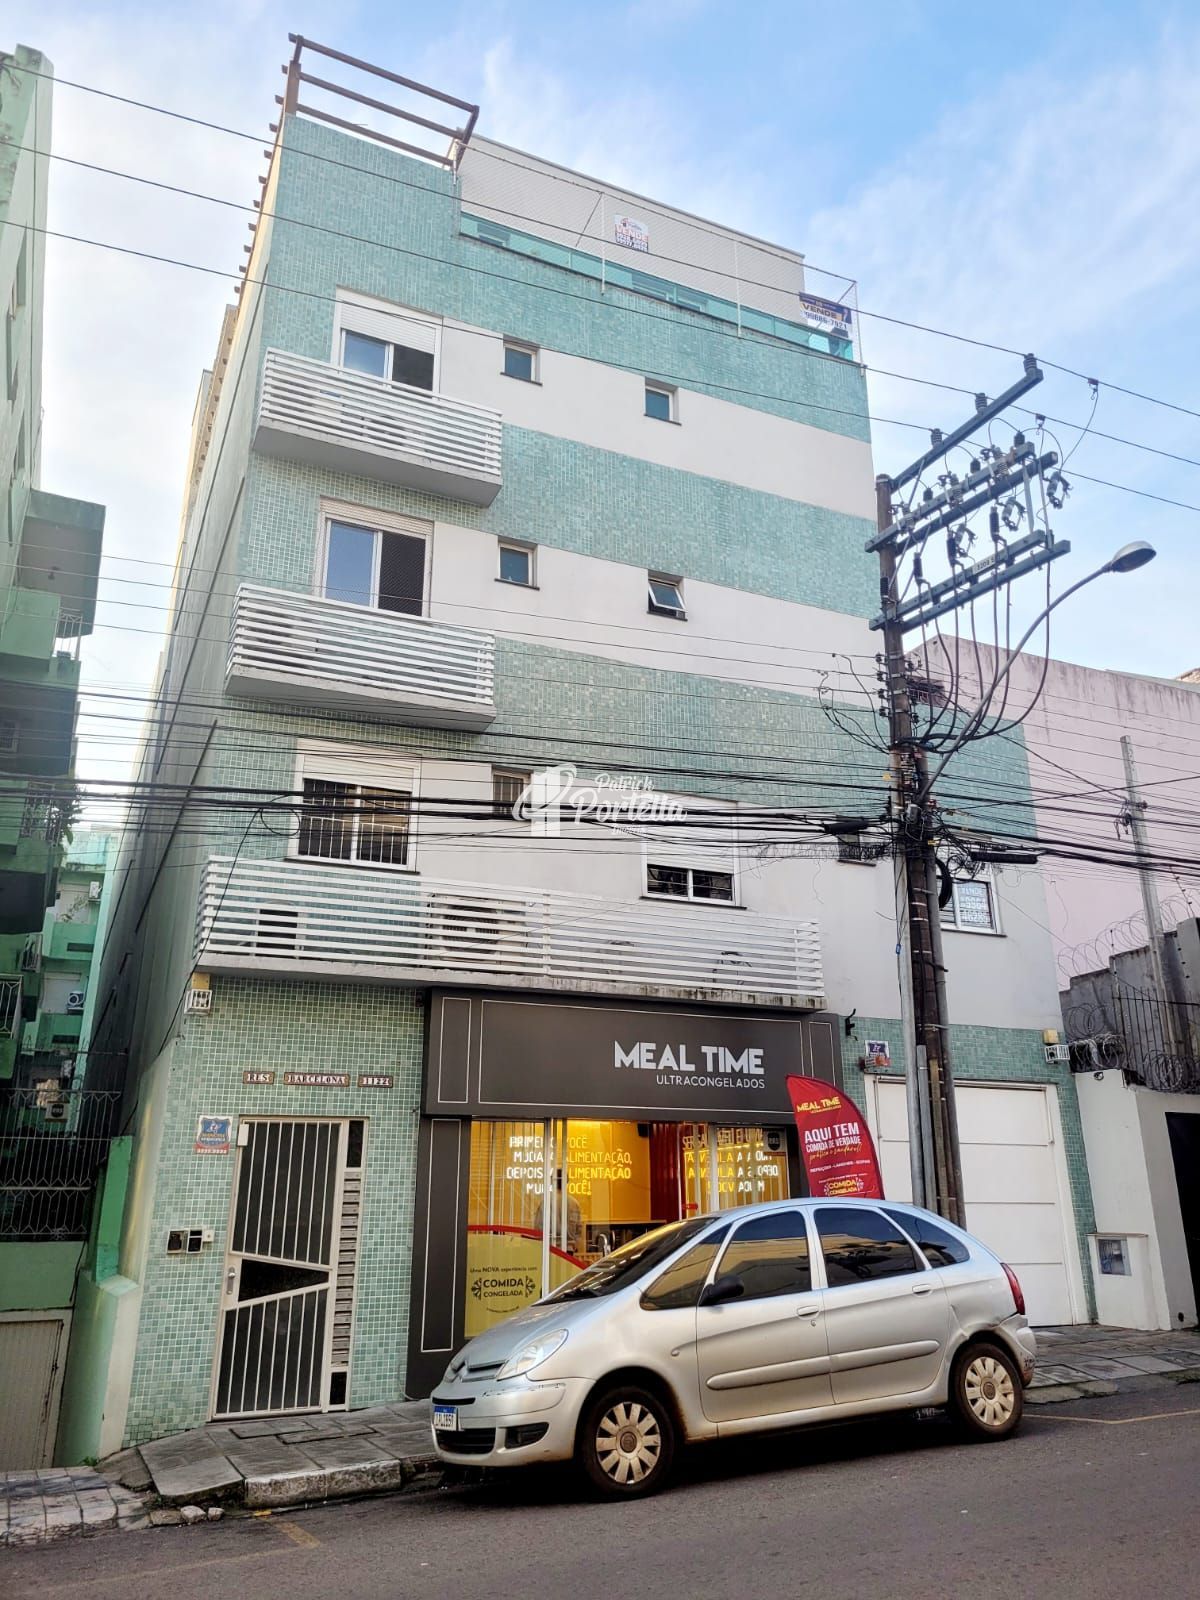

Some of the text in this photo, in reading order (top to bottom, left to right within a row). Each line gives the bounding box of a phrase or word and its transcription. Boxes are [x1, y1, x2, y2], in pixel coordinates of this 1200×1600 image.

[803, 303, 837, 318] VENDE
[614, 1040, 765, 1075] MEAL TIME
[288, 1074, 345, 1085] BARCELONA
[656, 1074, 765, 1089] ULTRACONGELADOS
[796, 1101, 821, 1113] MEAL
[820, 1096, 841, 1108] TIME
[804, 1122, 860, 1144] AQUI TEM
[567, 1136, 588, 1149] OCÊ
[805, 1136, 862, 1153] COMIDA DE VERDADE
[506, 1167, 543, 1179] DEPOIS
[567, 1163, 631, 1180] LIMENTAÇÃO
[566, 1179, 592, 1196] OCÊ!
[828, 1179, 857, 1190] COMIDA
[483, 1278, 524, 1288] COMIDA
[483, 1289, 524, 1298] CONGELADA
